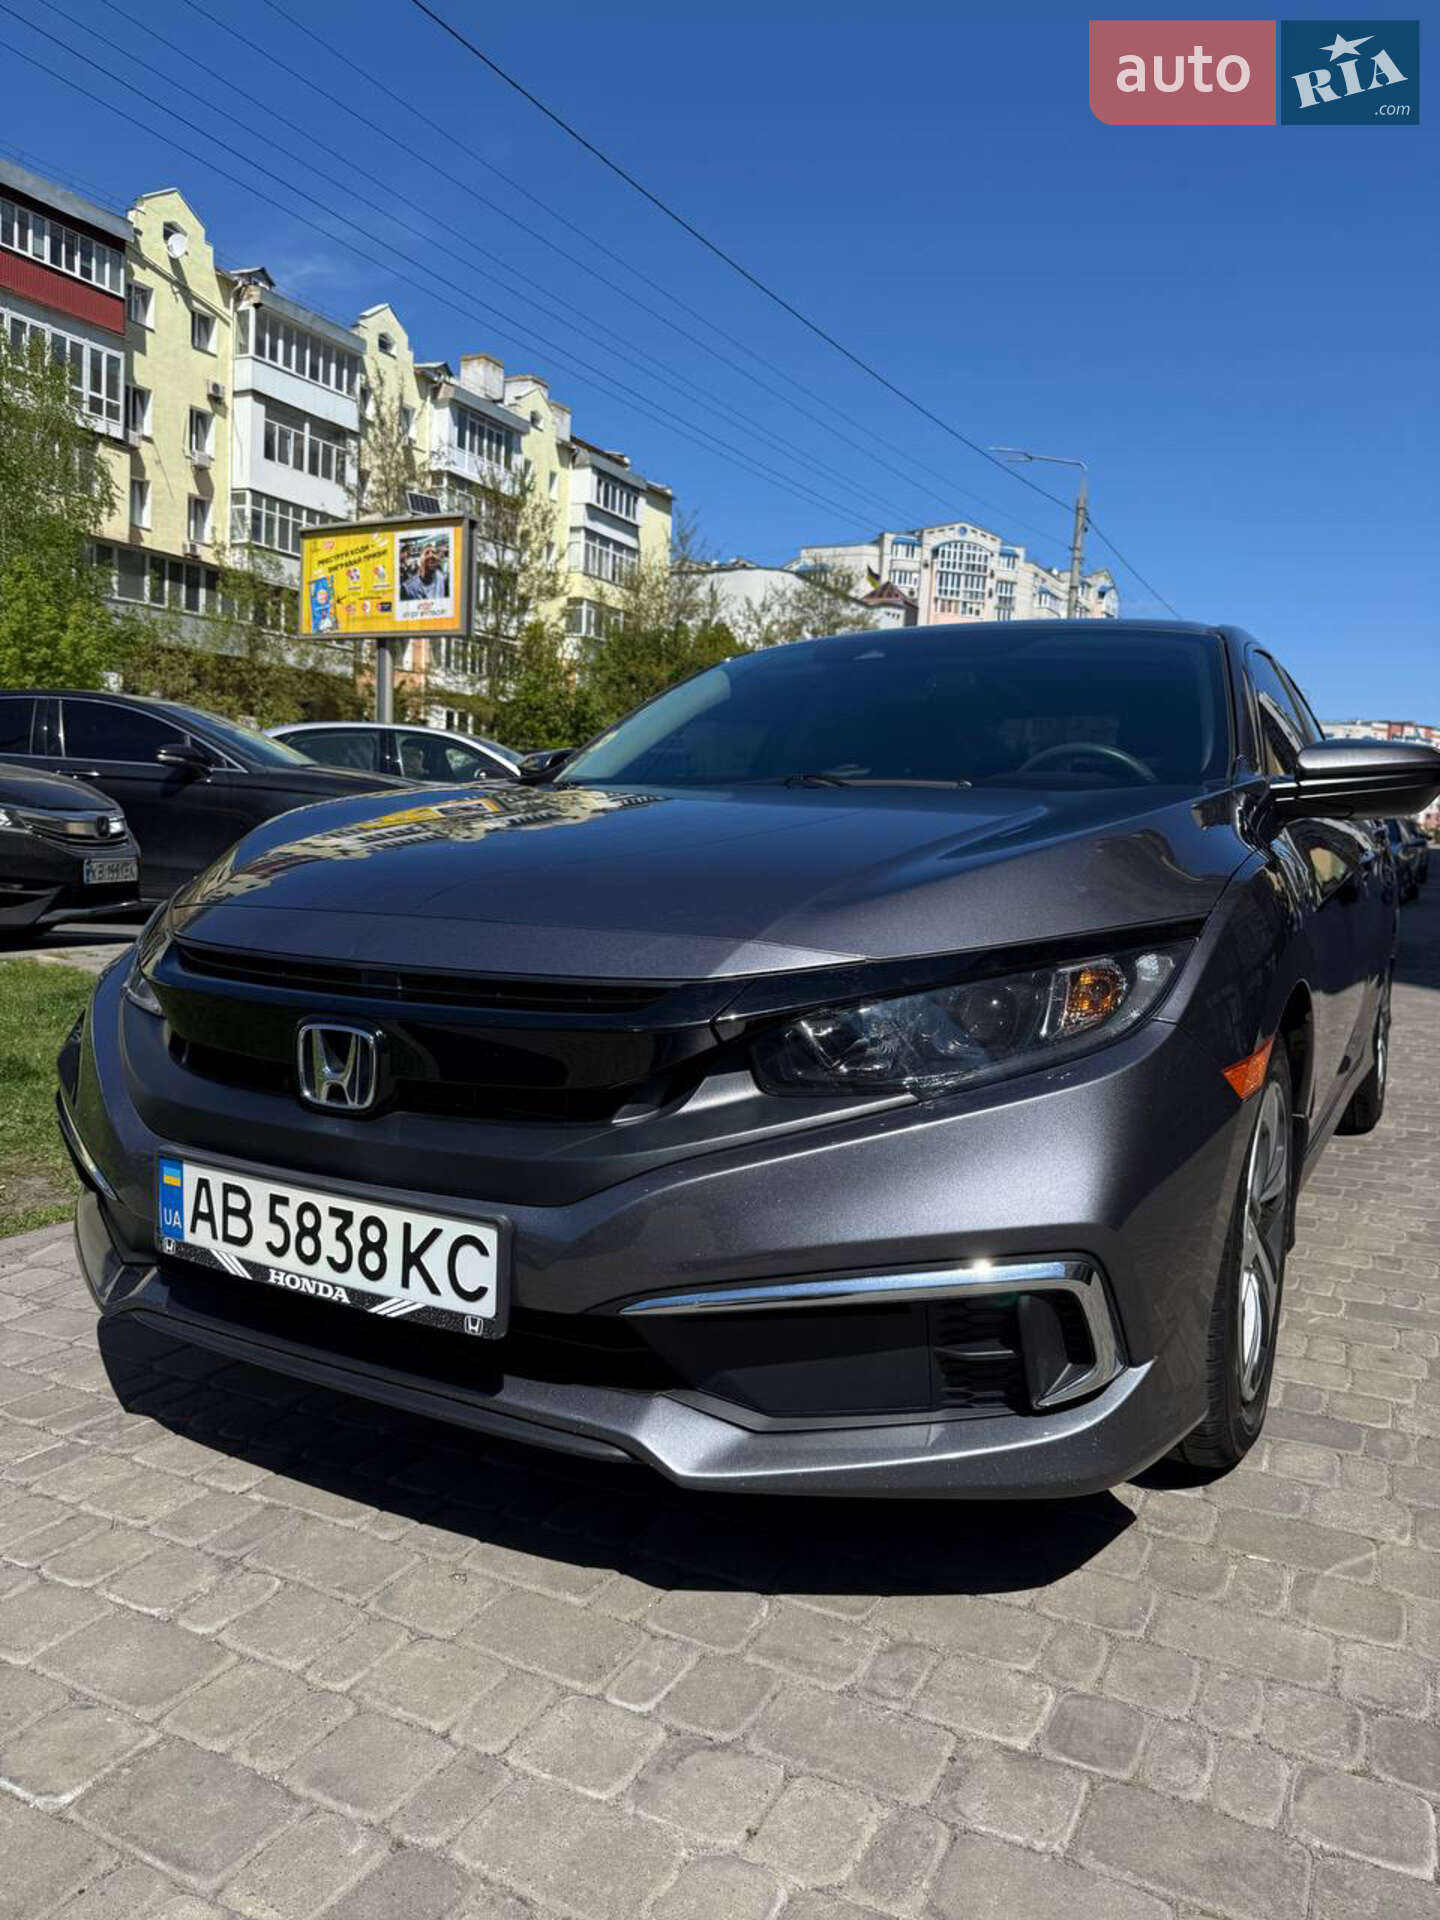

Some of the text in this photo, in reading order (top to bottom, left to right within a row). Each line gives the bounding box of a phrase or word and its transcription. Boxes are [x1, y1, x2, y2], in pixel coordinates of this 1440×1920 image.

[163, 1207, 183, 1229] UA
[189, 1177, 490, 1303] AB 5838 KC
[267, 1268, 351, 1305] HONDA
